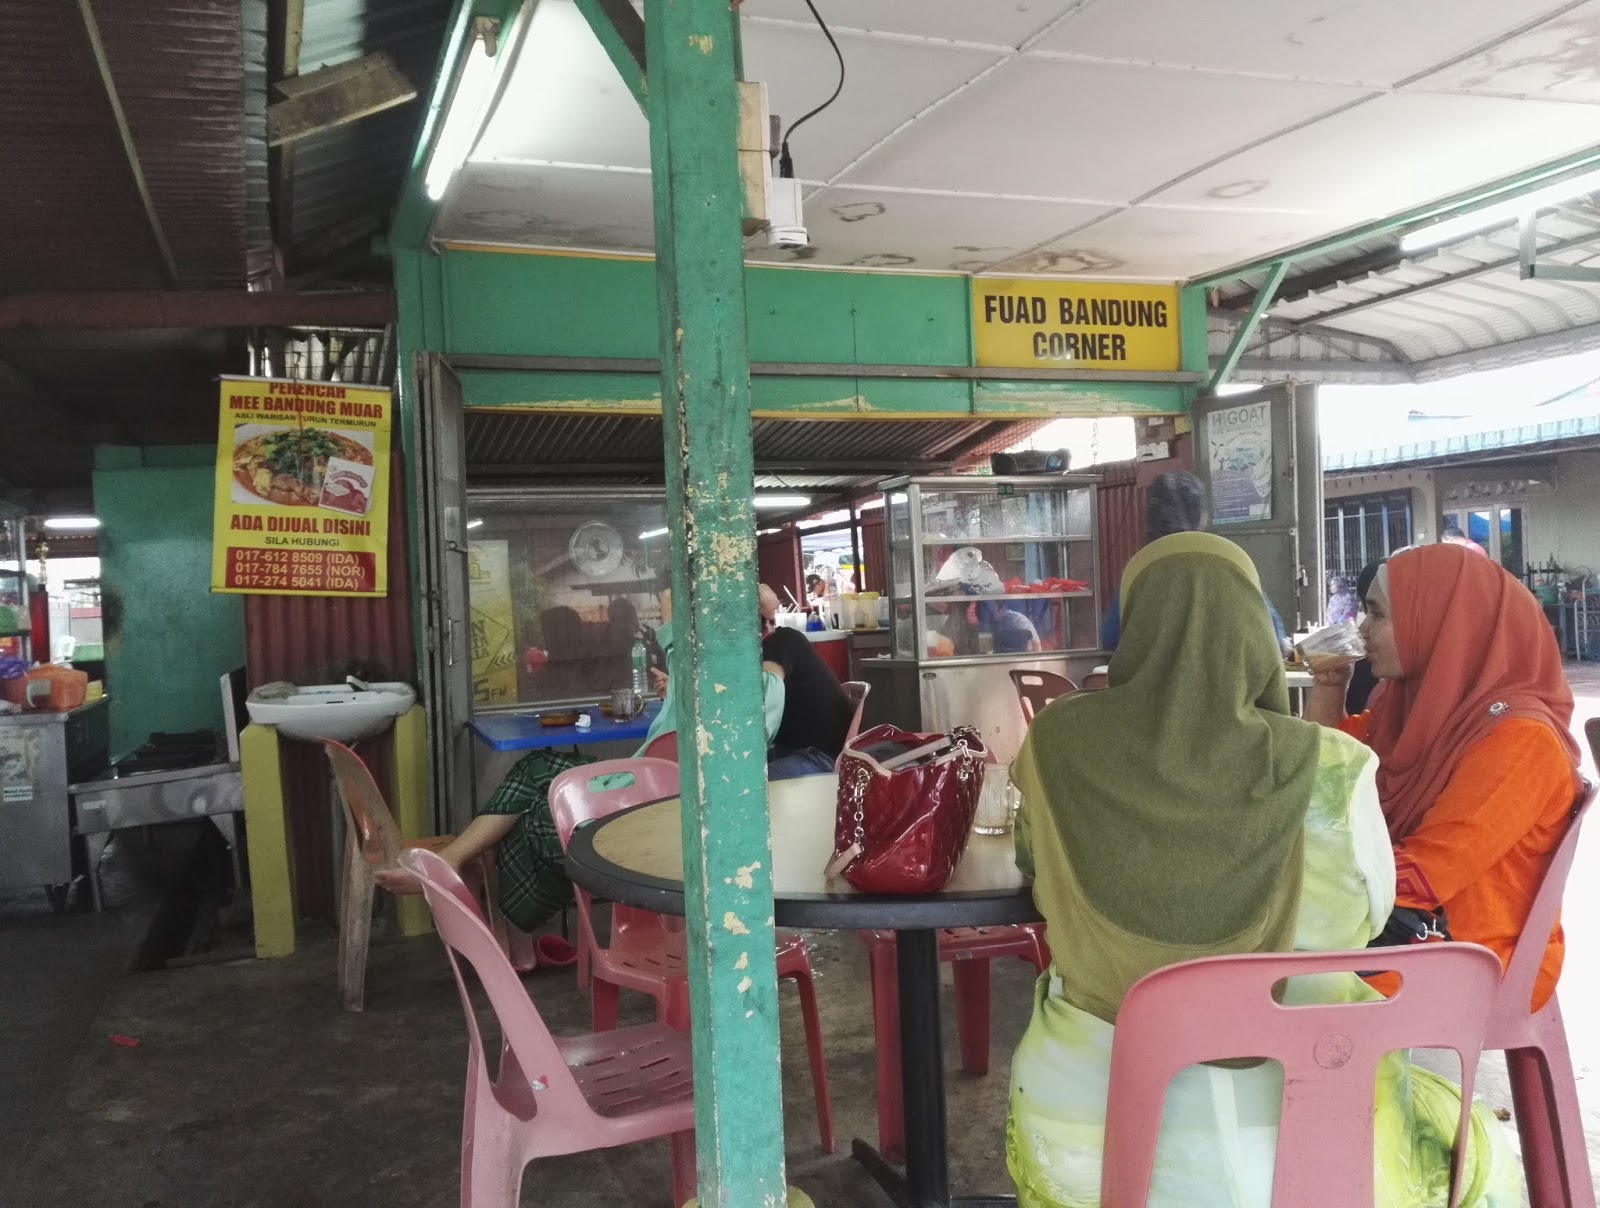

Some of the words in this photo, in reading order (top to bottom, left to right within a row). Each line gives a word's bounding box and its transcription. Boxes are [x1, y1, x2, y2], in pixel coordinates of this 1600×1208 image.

[984, 295, 1046, 324] FUAD
[1059, 297, 1168, 328] BANDUNG
[1033, 331, 1126, 361] CORNER
[229, 395, 260, 410] MEE
[263, 398, 335, 415] BANDUNG
[339, 403, 383, 419] MUAR
[234, 411, 254, 419] ASLI
[256, 413, 296, 421] WARISAN
[330, 417, 377, 427] TERMURUN
[230, 514, 263, 531] ADA
[267, 516, 319, 533] DIJUAL
[323, 519, 371, 536] DISINI
[265, 536, 289, 545] SILA
[291, 538, 340, 547] HUBUNGI
[235, 550, 288, 562] 017-612
[292, 552, 323, 563] 8509
[327, 553, 359, 566] (IDA)
[235, 563, 288, 575] 017-784
[292, 564, 323, 576] 7655
[326, 565, 366, 578] (NOR)
[234, 575, 288, 586] 017-274
[291, 577, 322, 588] 5041
[326, 577, 358, 591] (IDA)
